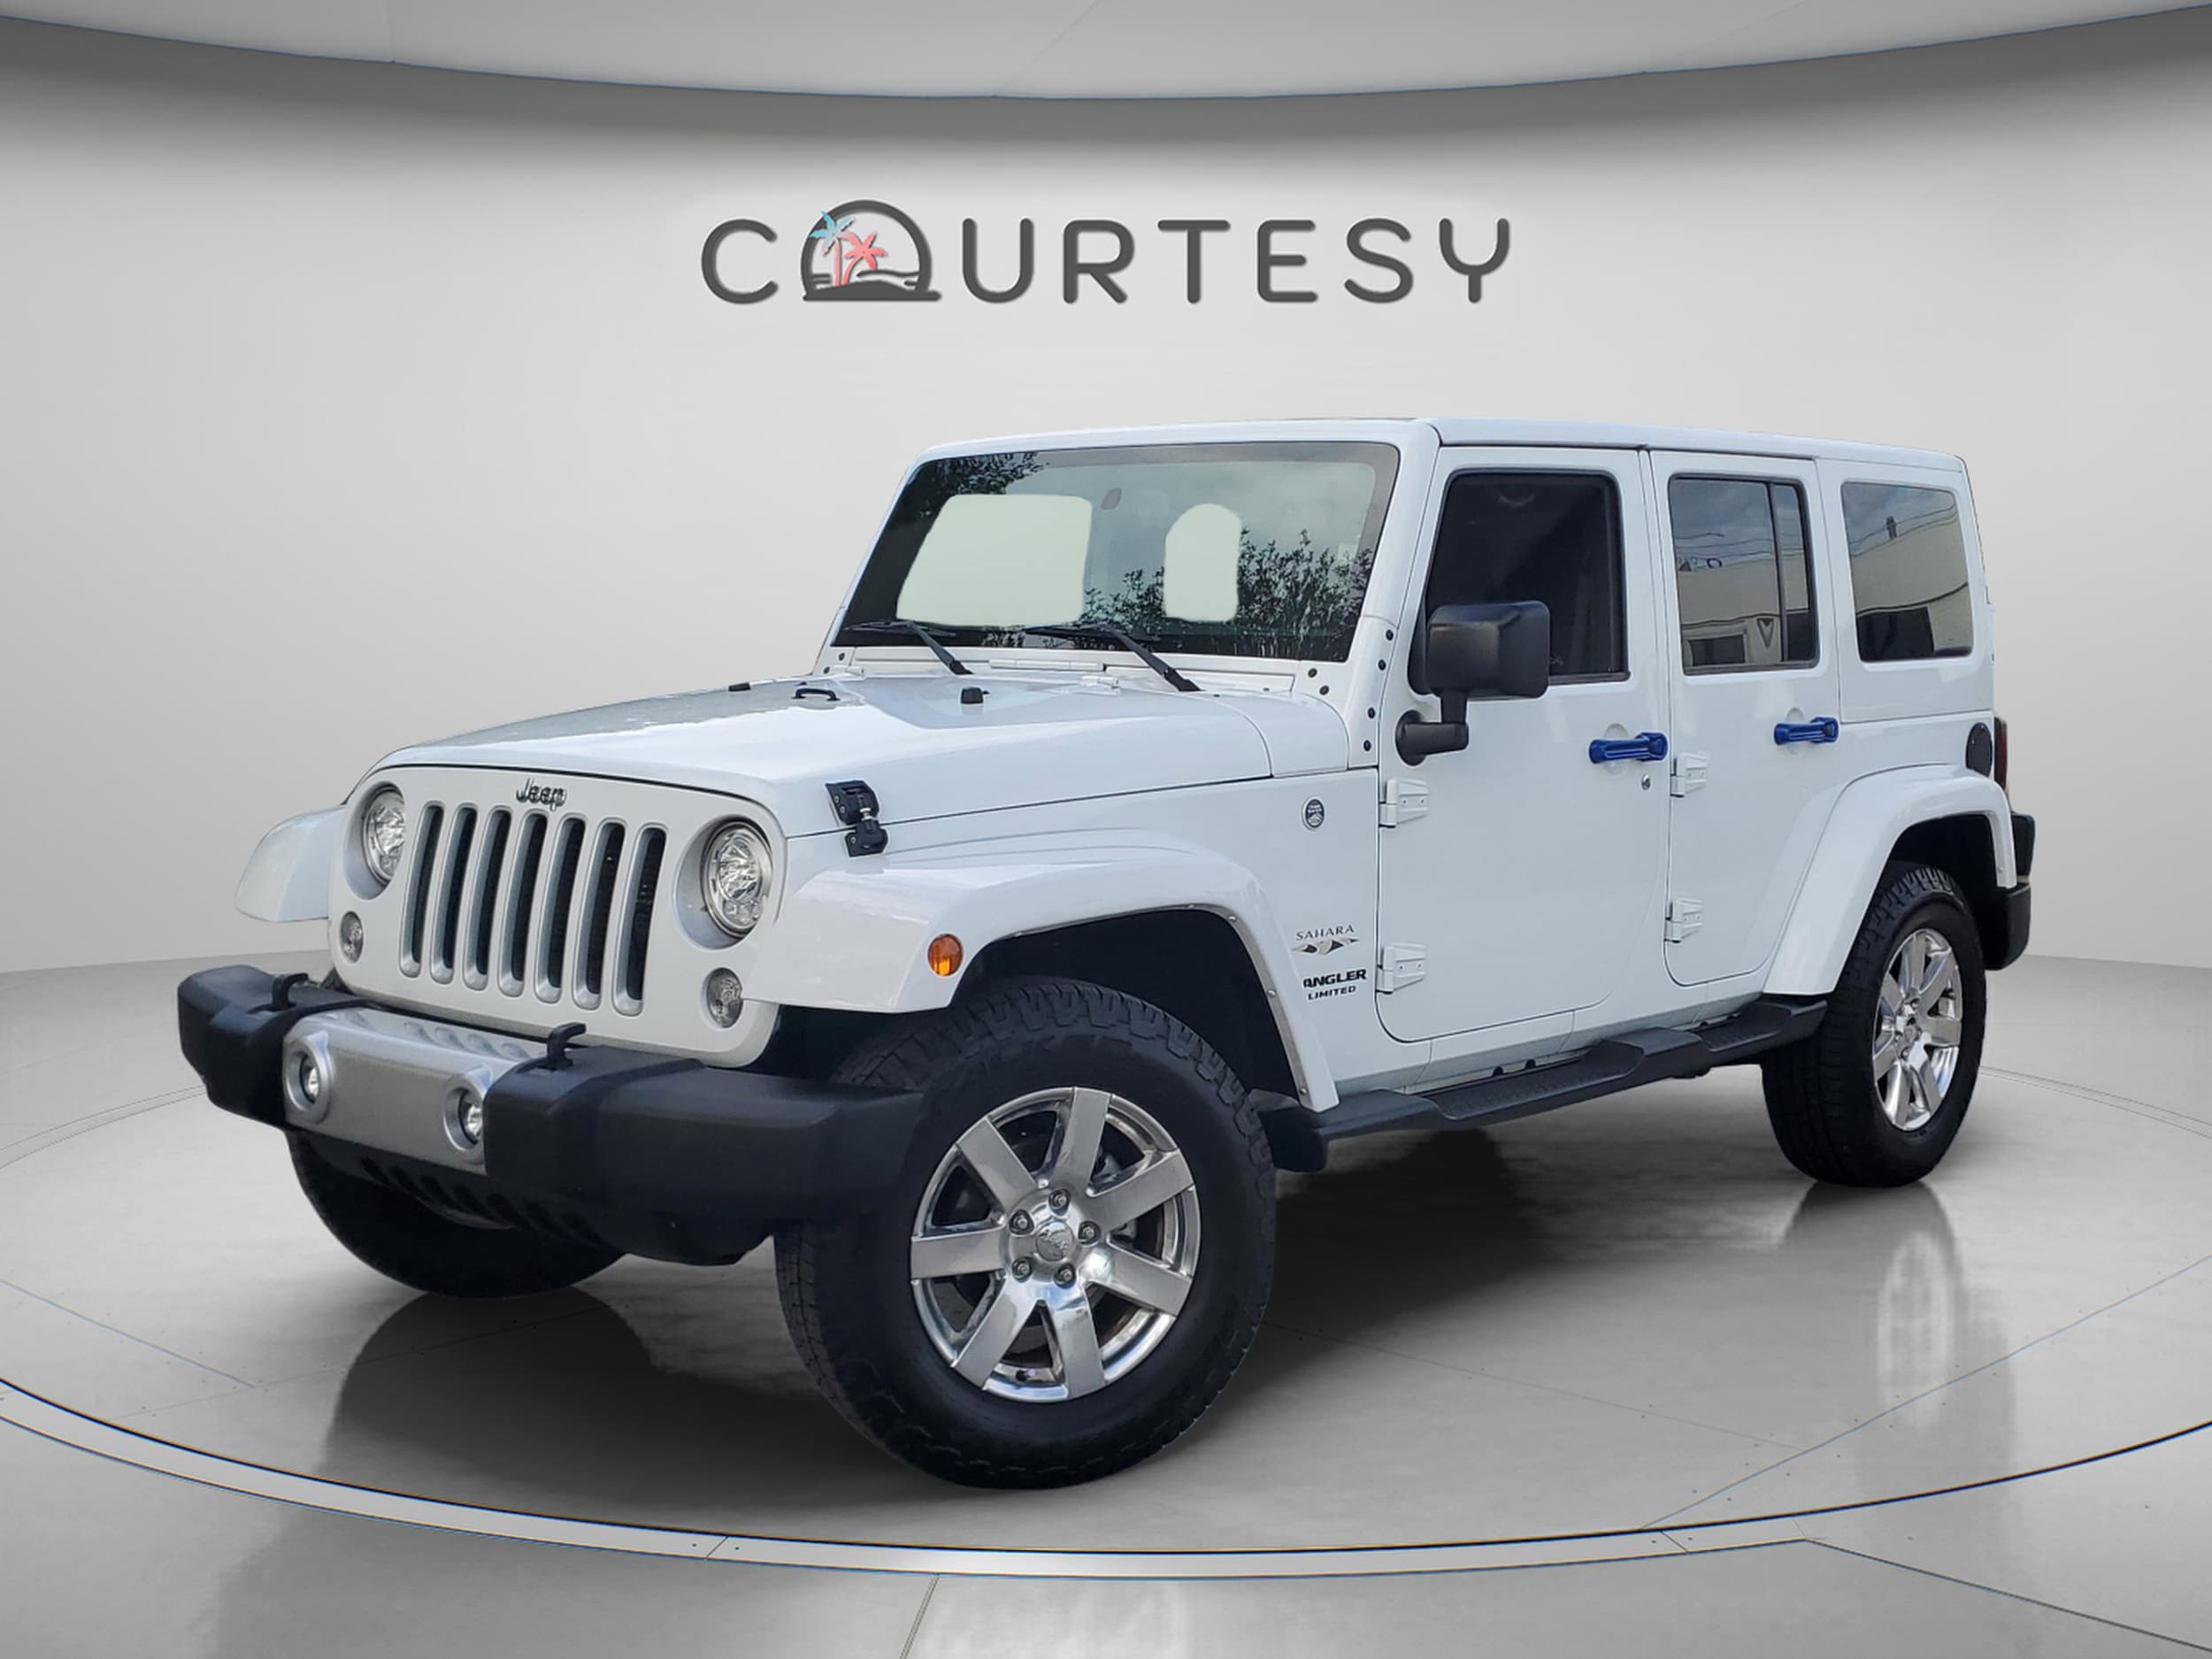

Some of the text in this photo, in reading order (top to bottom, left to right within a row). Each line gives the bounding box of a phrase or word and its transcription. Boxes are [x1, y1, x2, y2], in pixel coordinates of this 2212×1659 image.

[701, 199, 1510, 303] COURTESY
[516, 778, 567, 811] Jeep
[1295, 925, 1355, 941] SAHARA
[1308, 986, 1356, 1001] LIMITED
